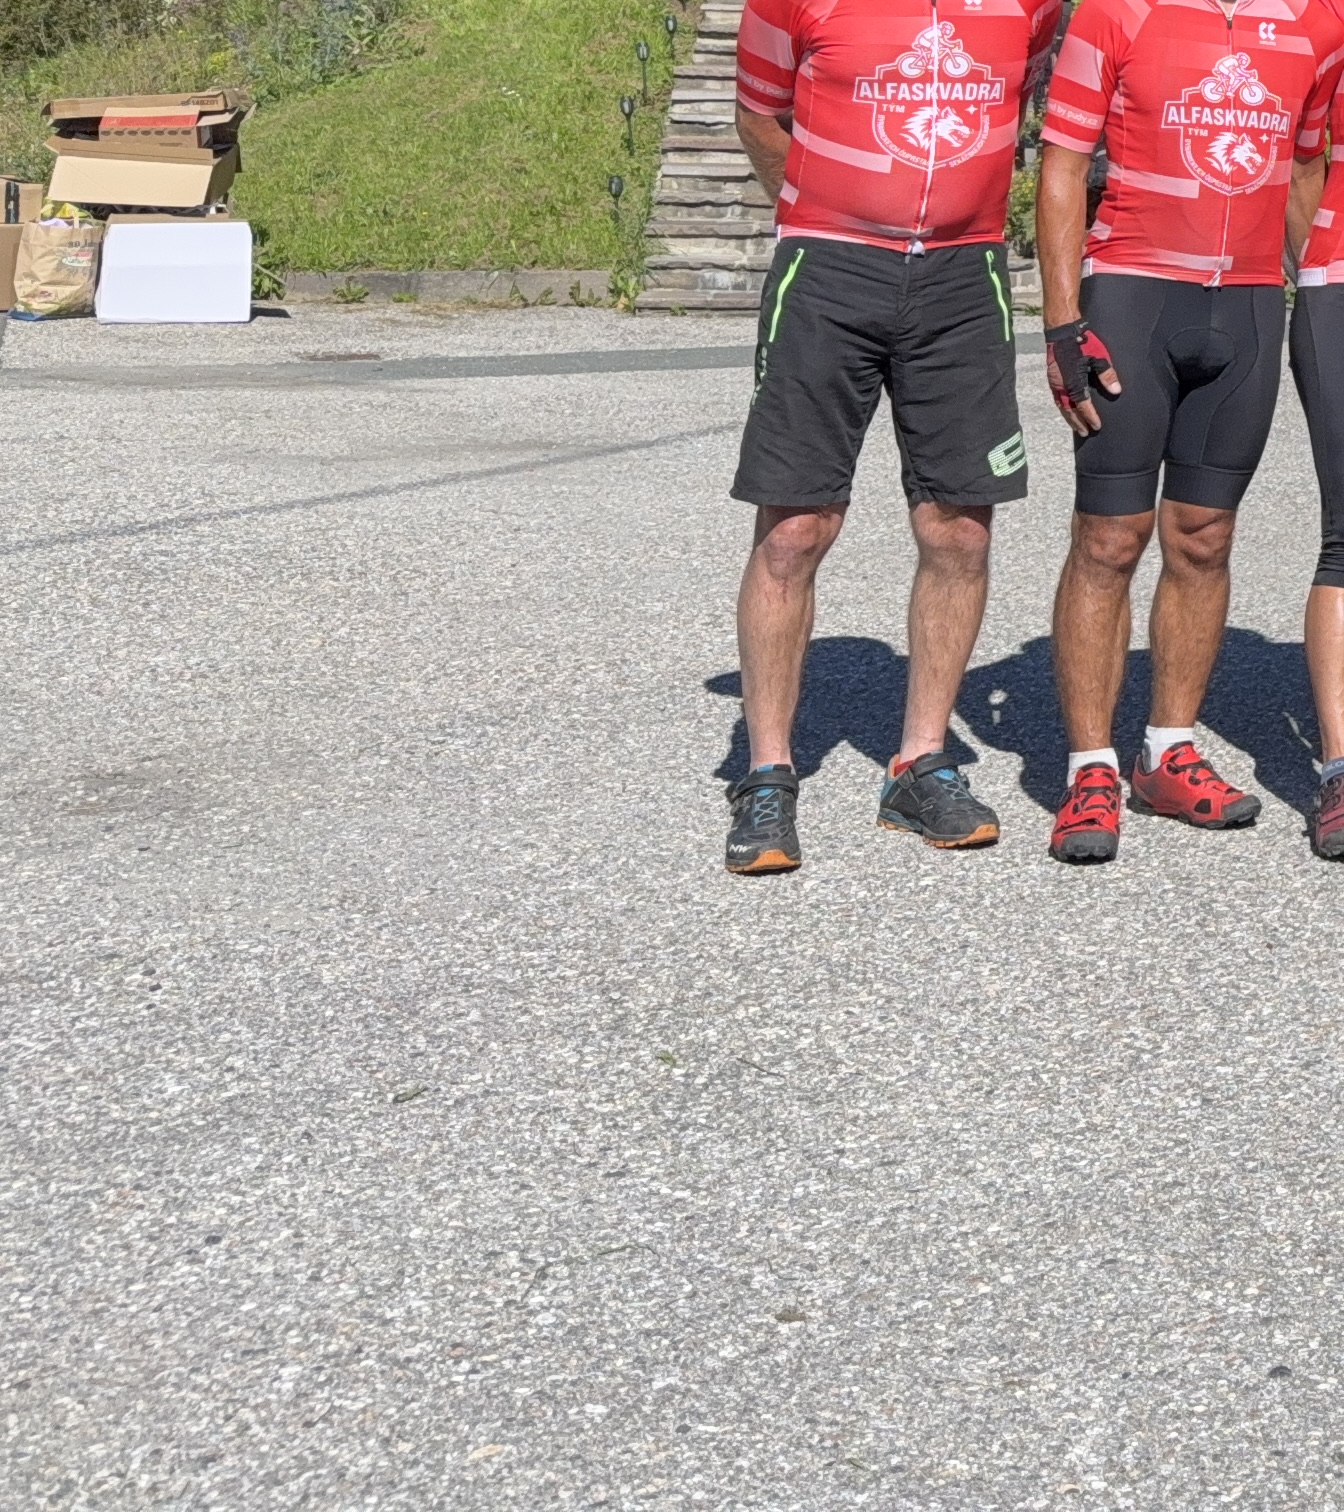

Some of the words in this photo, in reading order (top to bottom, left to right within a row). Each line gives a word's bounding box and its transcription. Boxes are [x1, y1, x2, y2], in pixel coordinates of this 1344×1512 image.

[859, 82, 1001, 101] ALFASKVADRA
[882, 102, 906, 114] TÝM
[1167, 106, 1289, 133] ALFASKVADRA
